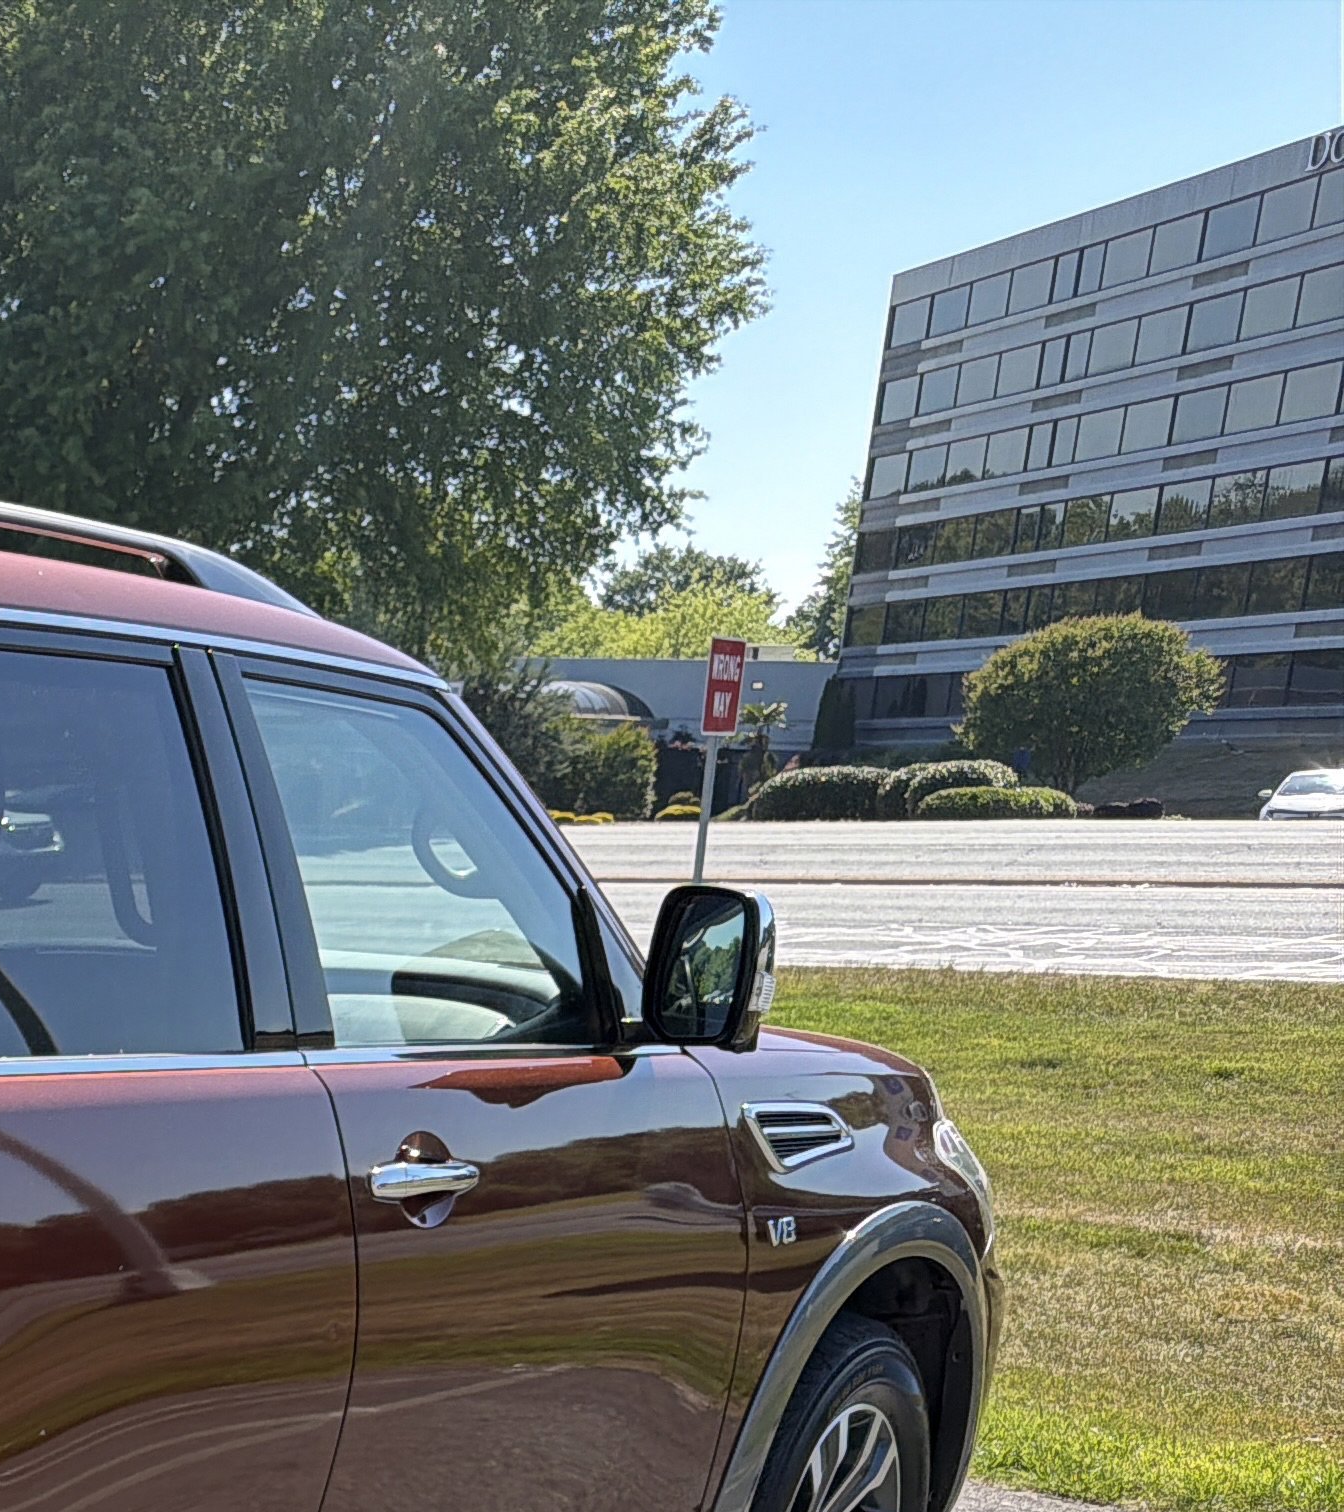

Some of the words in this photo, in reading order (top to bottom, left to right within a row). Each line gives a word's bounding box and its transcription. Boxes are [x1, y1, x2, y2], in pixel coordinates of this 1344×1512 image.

[712, 653, 741, 682] WRONG
[712, 691, 733, 719] WAY
[767, 1216, 797, 1248] V8
